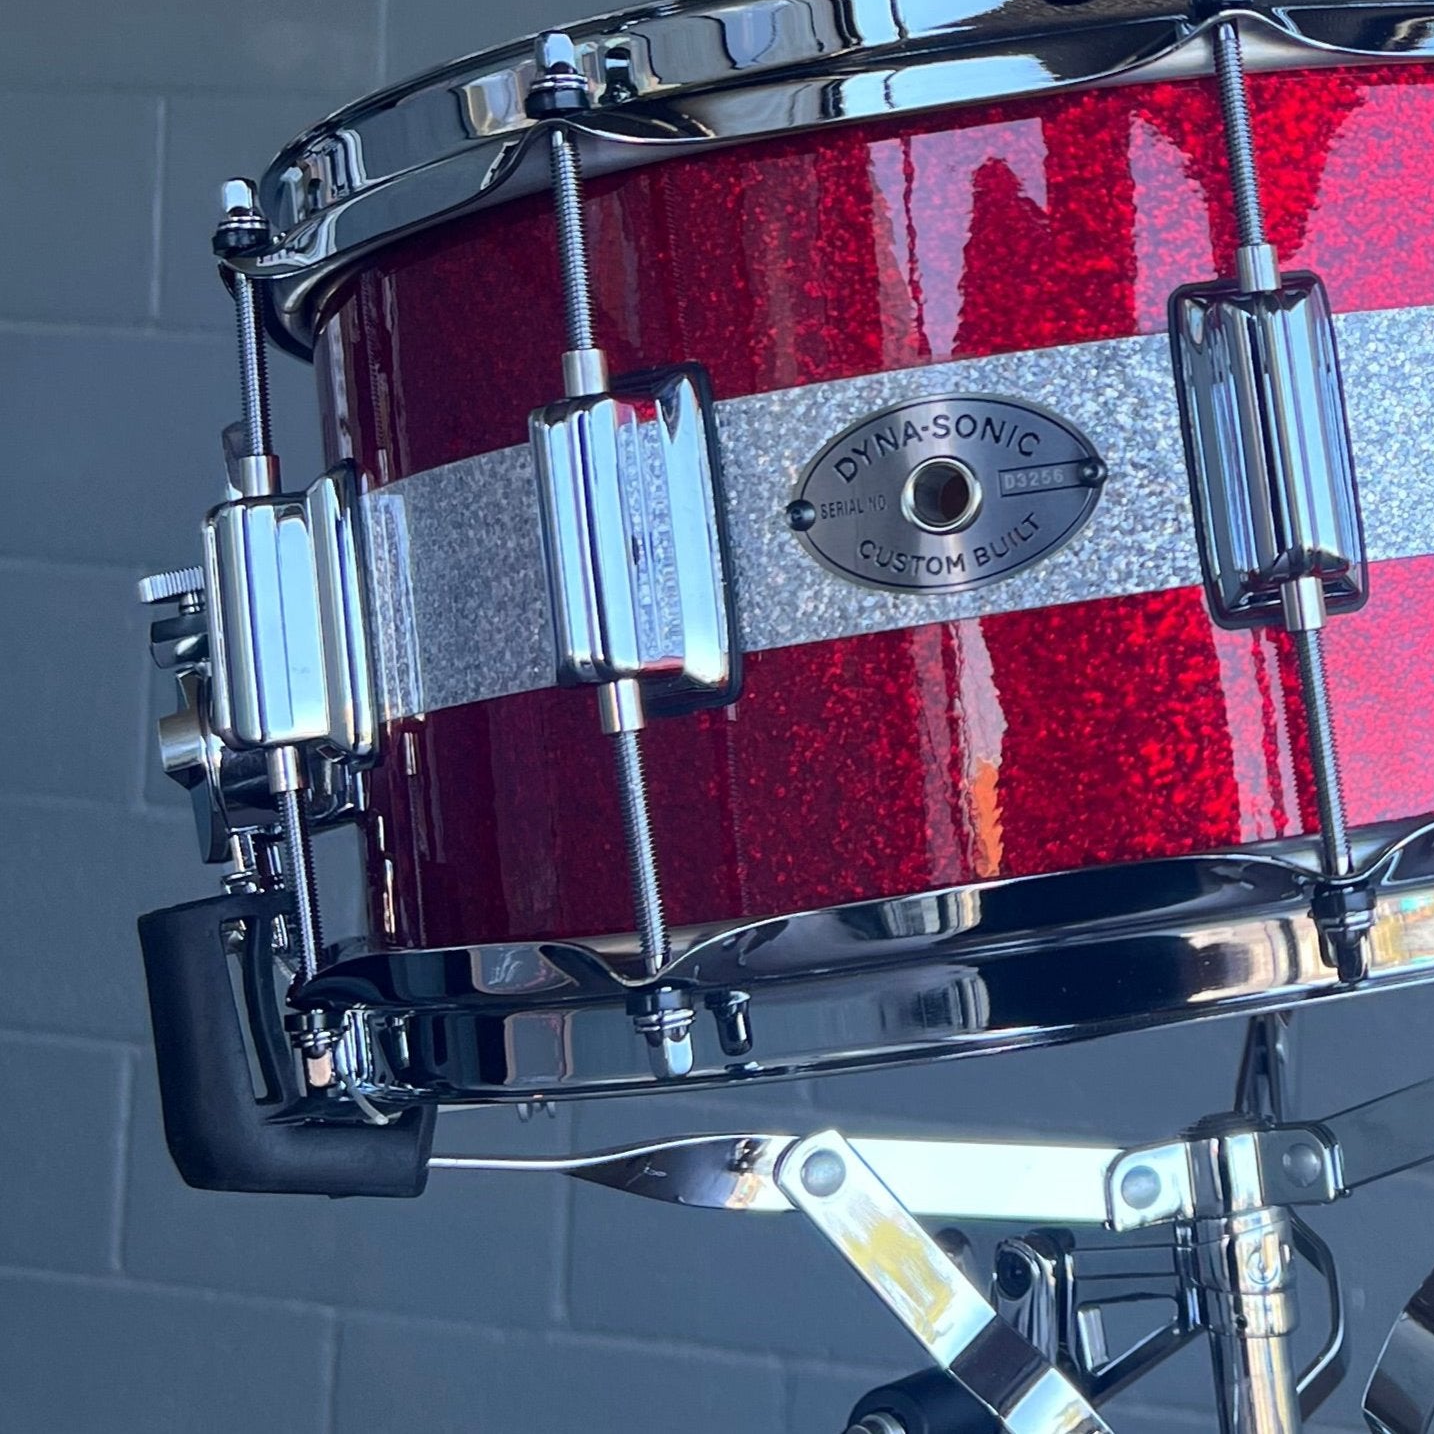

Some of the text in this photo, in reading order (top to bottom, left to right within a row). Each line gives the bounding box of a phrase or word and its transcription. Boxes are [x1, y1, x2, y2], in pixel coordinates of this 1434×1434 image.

[833, 413, 1041, 484] DYNA-SONIC
[820, 498, 864, 520] SERIAL
[1003, 469, 1065, 490] D3256
[858, 511, 1041, 576] CUSTOM BUILT
